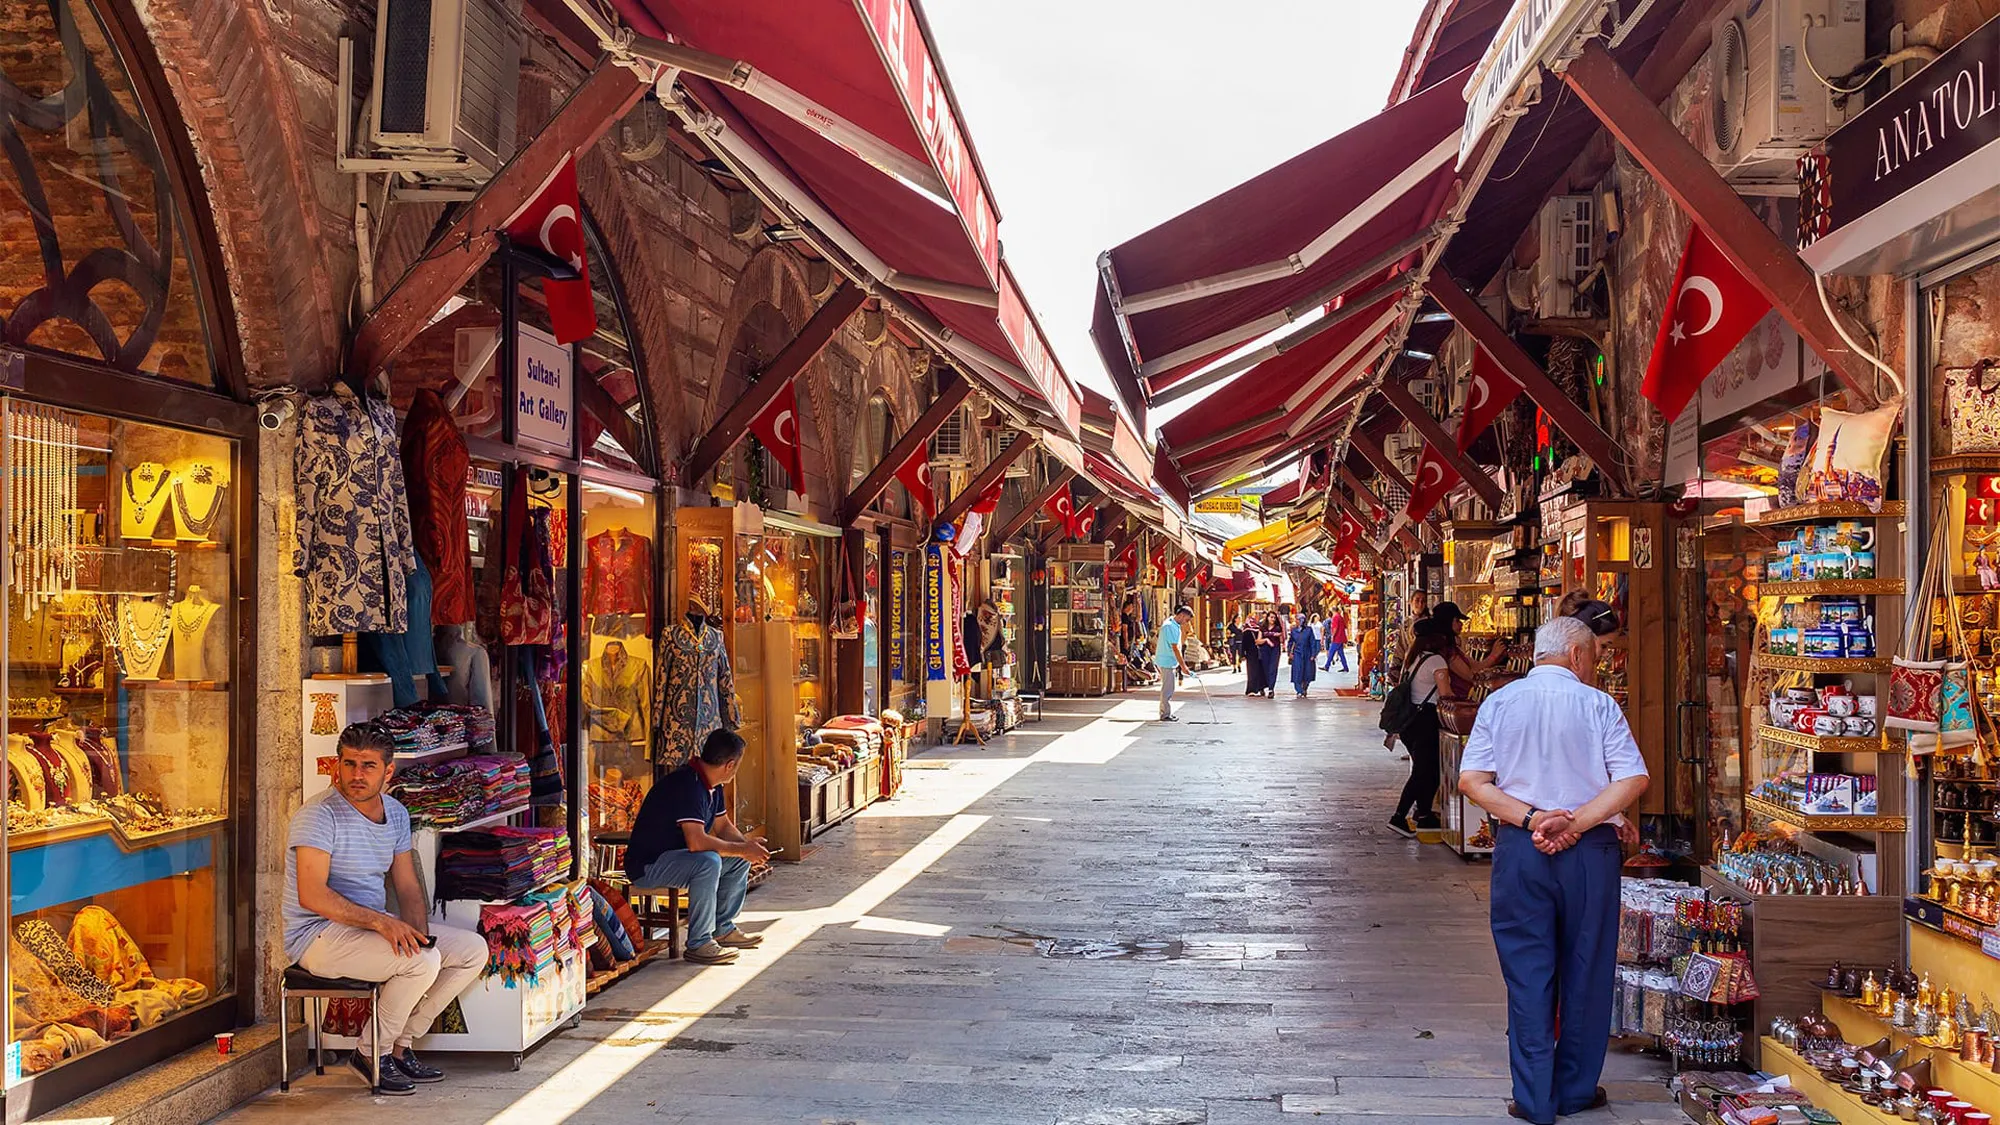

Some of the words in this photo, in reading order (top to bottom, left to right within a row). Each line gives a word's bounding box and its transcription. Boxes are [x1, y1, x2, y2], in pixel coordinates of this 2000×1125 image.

[1874, 60, 2000, 182] ANATOL
[527, 356, 561, 389] Sultan-i
[519, 391, 534, 416] Art
[538, 397, 568, 431] Gallery
[1220, 501, 1239, 510] MUSEUM
[929, 569, 939, 639] BARCELONA
[930, 642, 939, 655] FC
